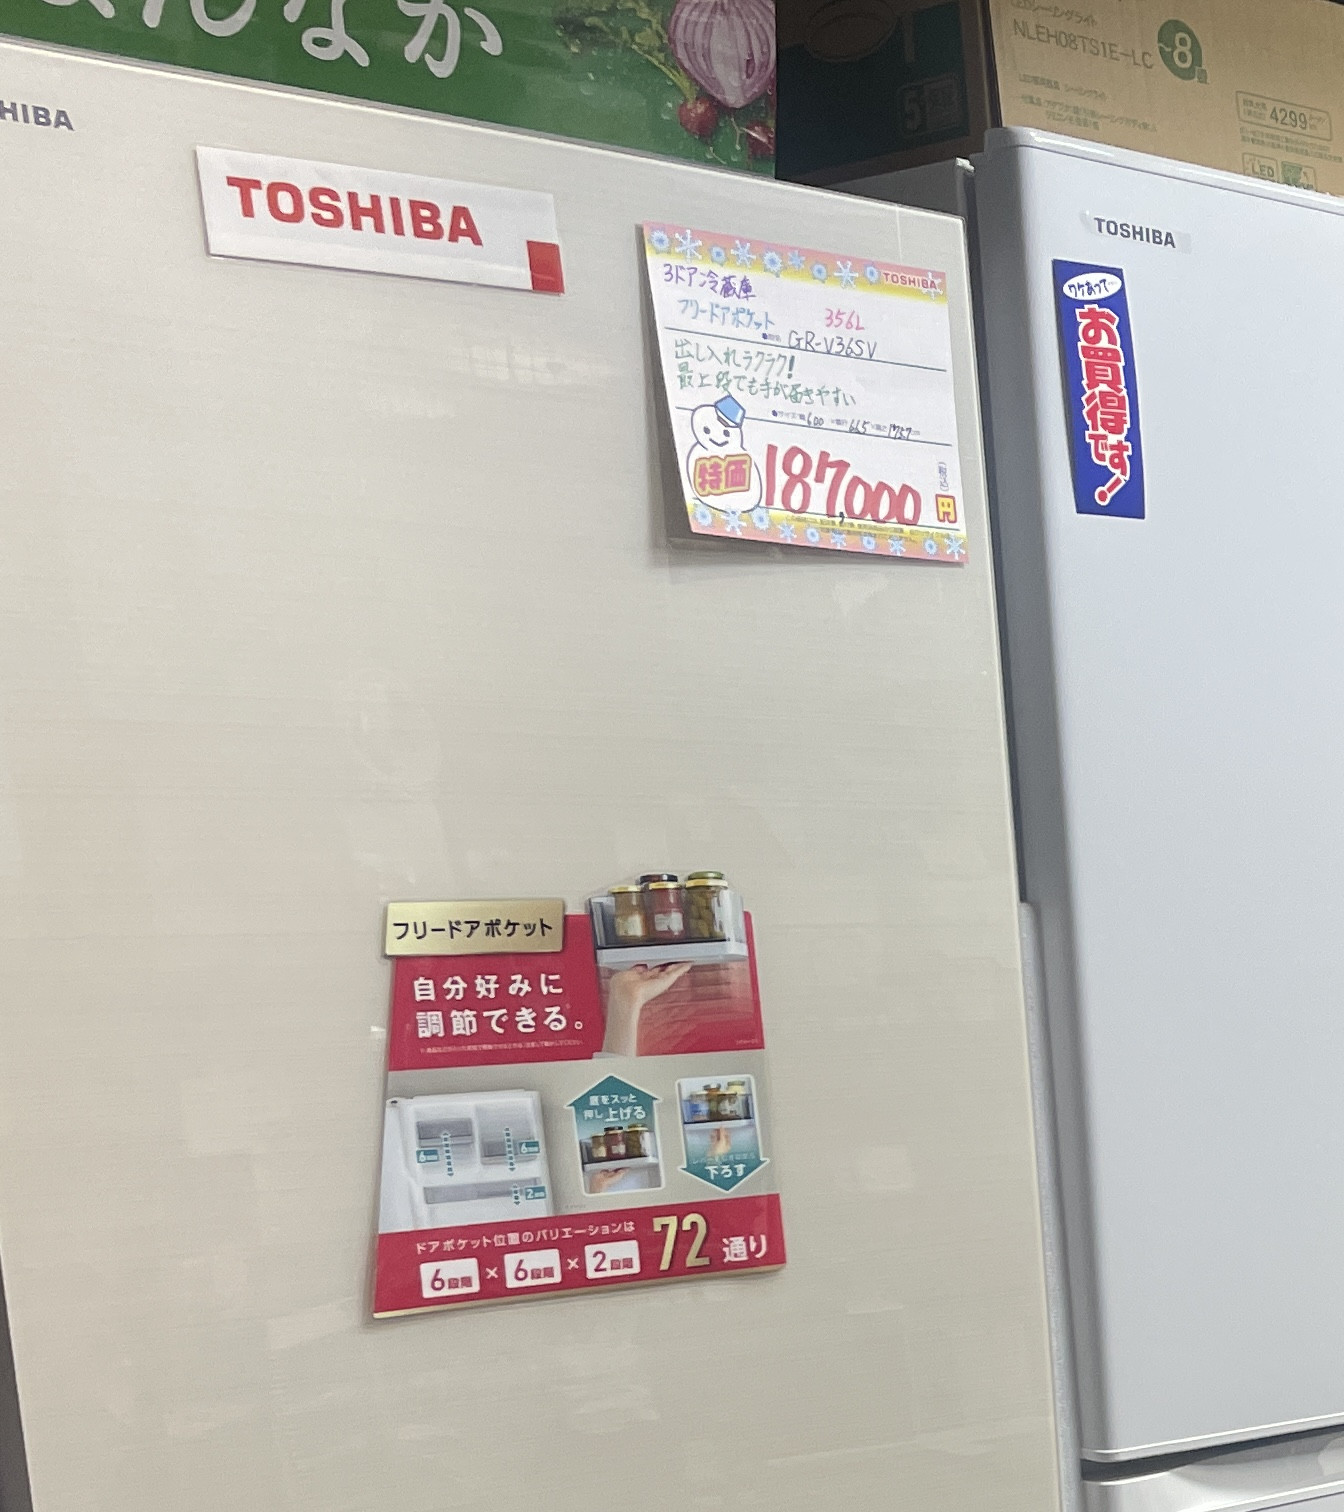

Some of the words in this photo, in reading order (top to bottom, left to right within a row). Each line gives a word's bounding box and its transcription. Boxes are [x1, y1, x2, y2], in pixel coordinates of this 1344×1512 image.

[1013, 18, 1155, 70] NLEH08TS1E-LC
[1269, 102, 1308, 130] 4299
[1251, 159, 1275, 178] LED
[226, 176, 485, 247] TOSHIBA
[1094, 216, 1176, 249] TOSHIBA
[662, 263, 757, 300] 3ドア冷蔵庫
[882, 271, 938, 290] TOSHIBA
[824, 308, 866, 332] 356L
[788, 331, 878, 360] GR-V36SV
[1075, 304, 1132, 506] お買得です!
[694, 455, 752, 496] 特価
[392, 917, 555, 942] フリードアポケット
[413, 972, 565, 1002] 自分好みに
[417, 1005, 584, 1038] 調節できる。
[705, 1162, 747, 1179] 下ろす
[415, 1218, 636, 1255] ドアポケット位置のバリエーションは
[430, 1265, 474, 1292] 6段階
[513, 1255, 556, 1280] 6段階
[590, 1247, 636, 1274] 2段階
